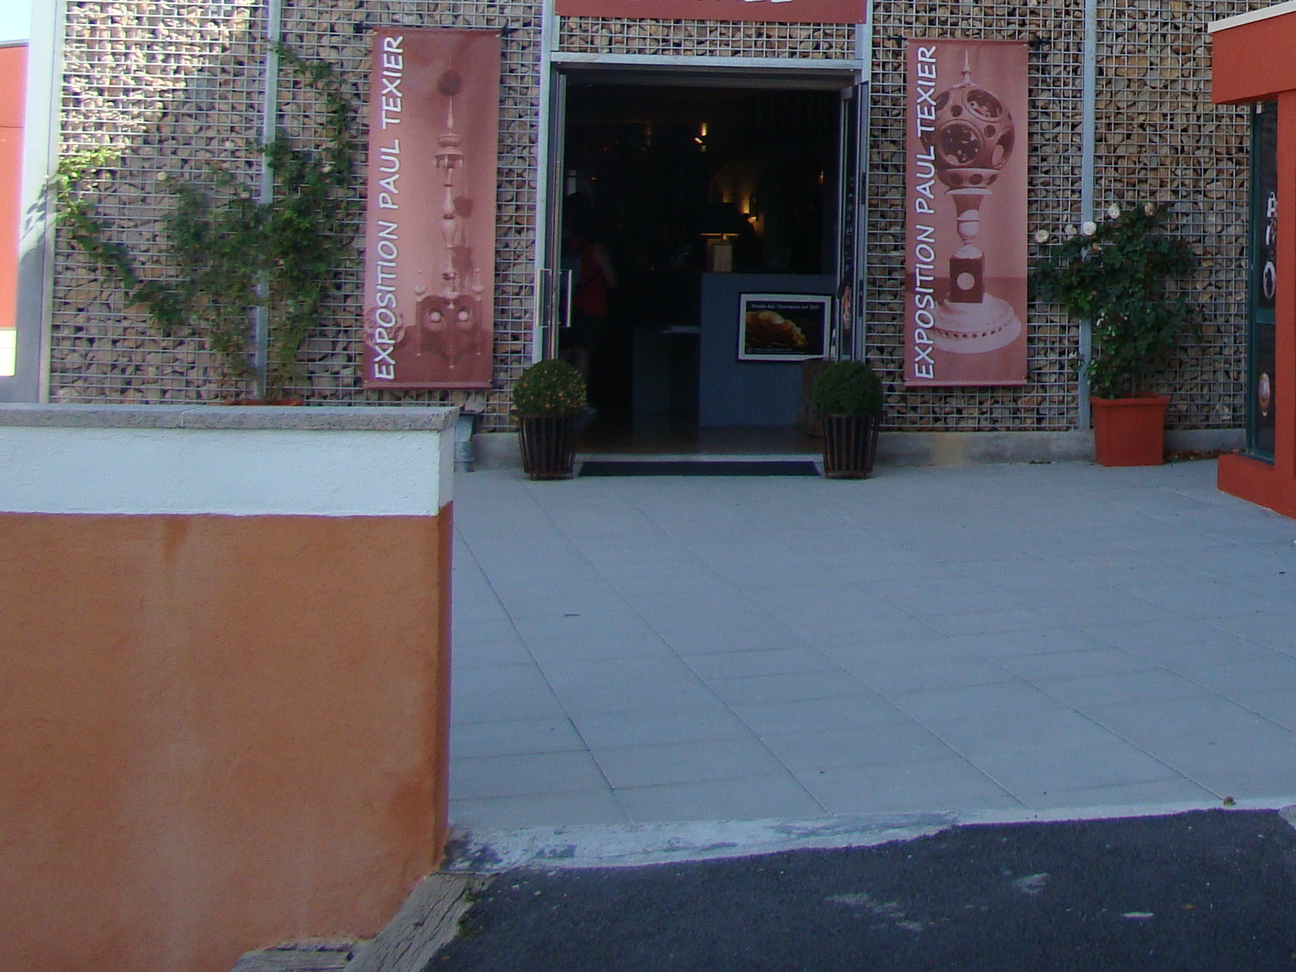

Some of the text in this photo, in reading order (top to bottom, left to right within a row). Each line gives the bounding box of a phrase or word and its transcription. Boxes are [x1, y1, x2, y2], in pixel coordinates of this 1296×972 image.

[374, 35, 404, 381] EXPOSITION PAUL TEXIER
[914, 45, 938, 380] EXPOSITION PAUL TEXIER
